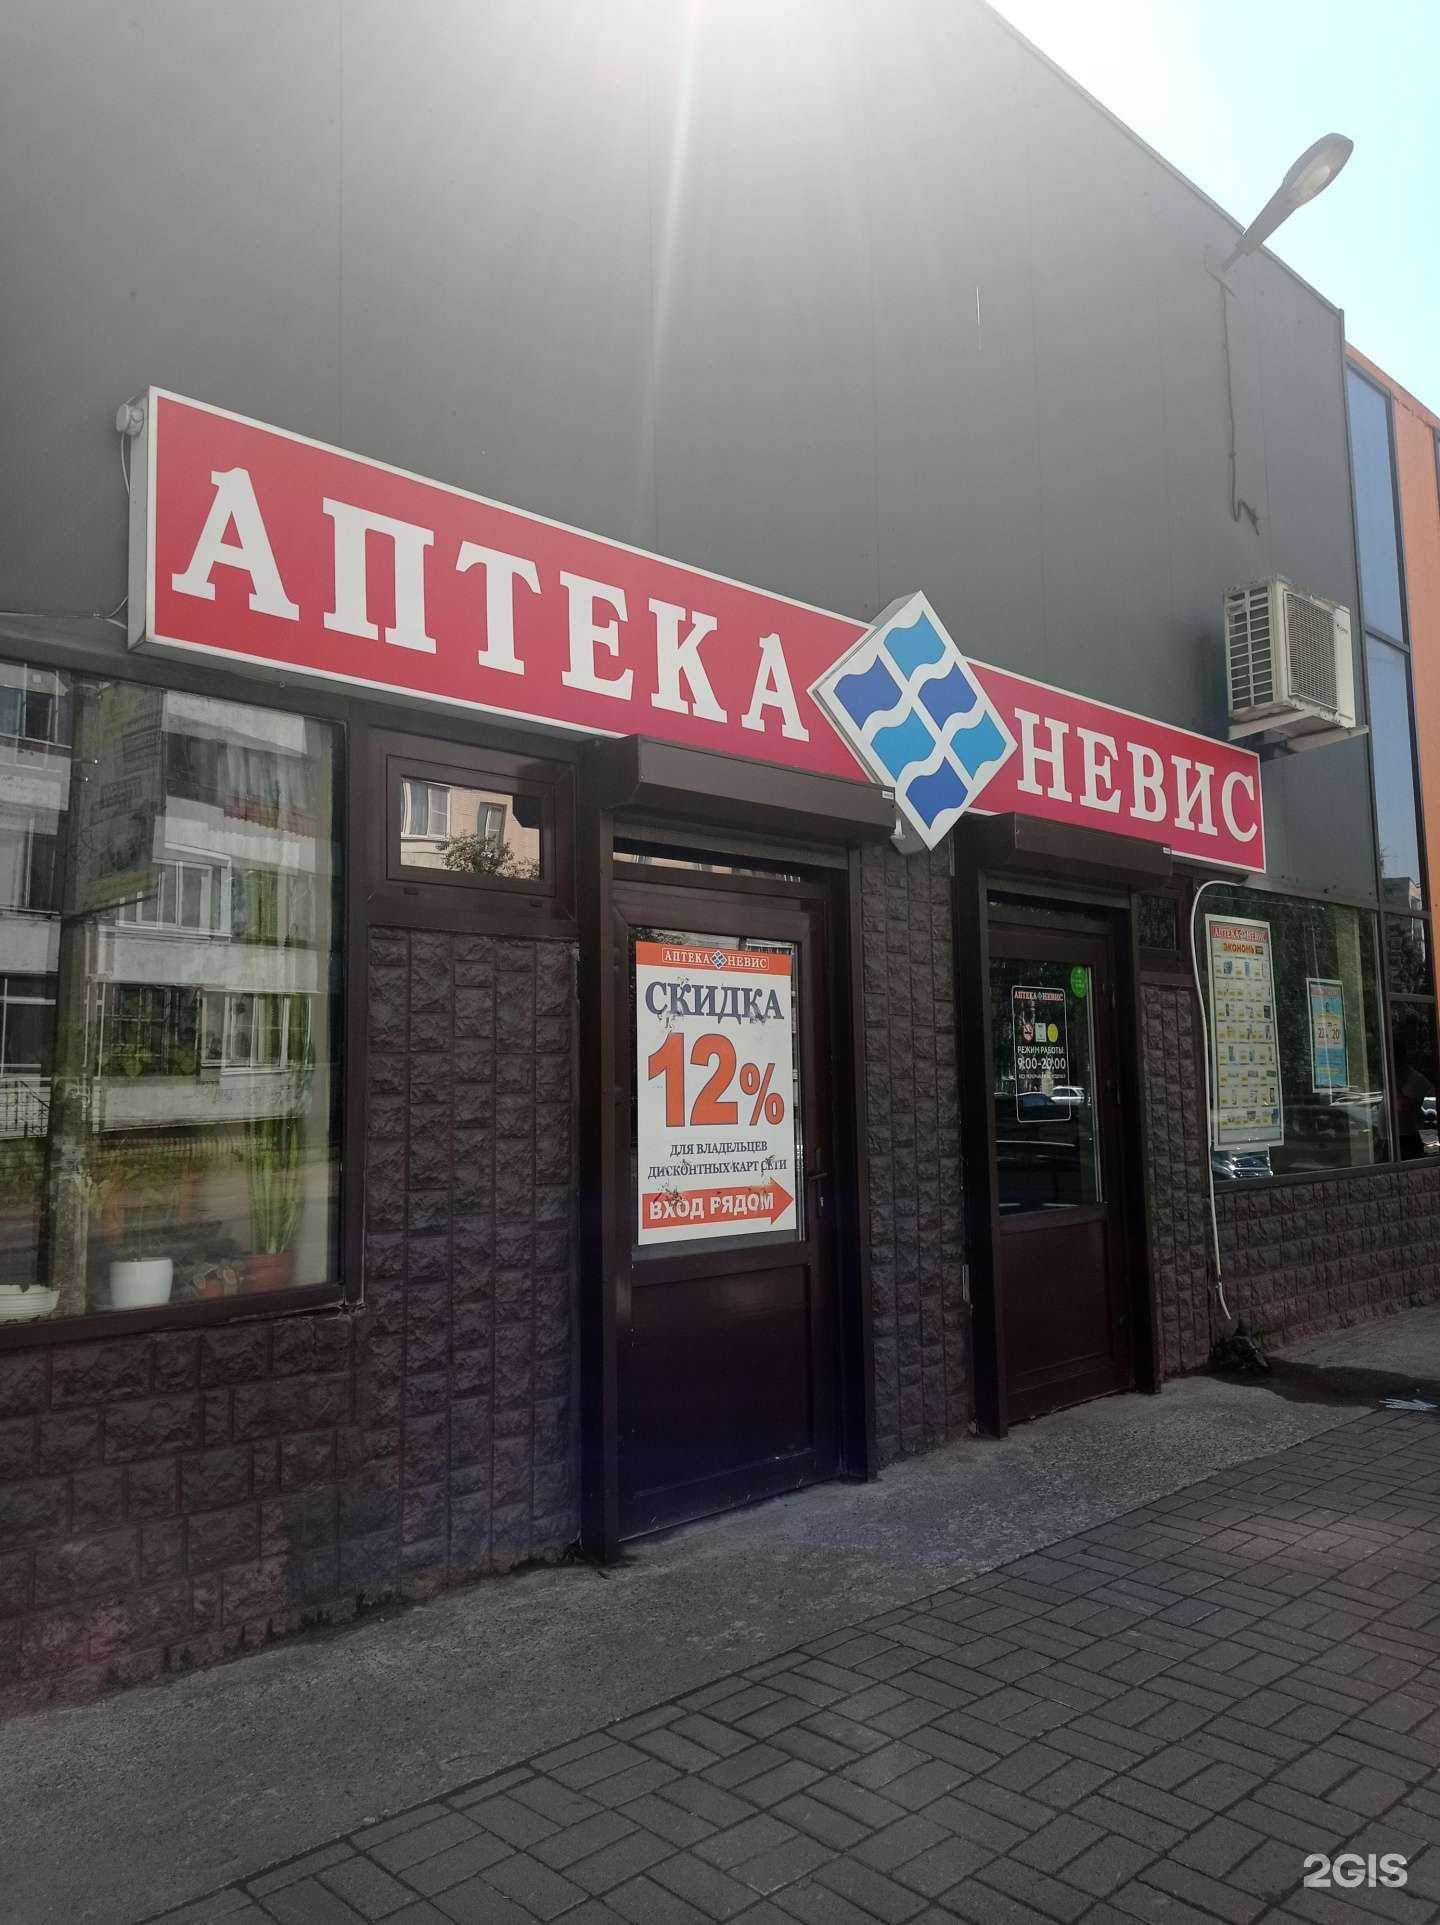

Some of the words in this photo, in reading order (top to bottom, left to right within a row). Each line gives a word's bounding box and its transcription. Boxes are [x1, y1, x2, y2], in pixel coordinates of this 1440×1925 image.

[172, 467, 811, 742] АПТЕКА
[1014, 707, 1258, 843] НЕВИС
[664, 950, 710, 964] АПТЕКА
[727, 956, 768, 968] НЕВИС
[645, 981, 785, 1025] СКИДКА
[1017, 1045, 1040, 1054] РЕЖИМ
[1040, 1046, 1064, 1054] РАБОТЫ
[648, 1032, 785, 1127] 12%
[670, 1144, 694, 1158] ДЛЯ
[696, 1141, 768, 1155] ВЛАДЕЛЬЦЕВ
[648, 1163, 731, 1180] ДИСКОНТНЫХ
[732, 1160, 760, 1172] КАРТ
[760, 1159, 788, 1171] СЕТИ
[650, 1197, 705, 1220] ВХОД
[710, 1192, 774, 1216] РЯДОМ
